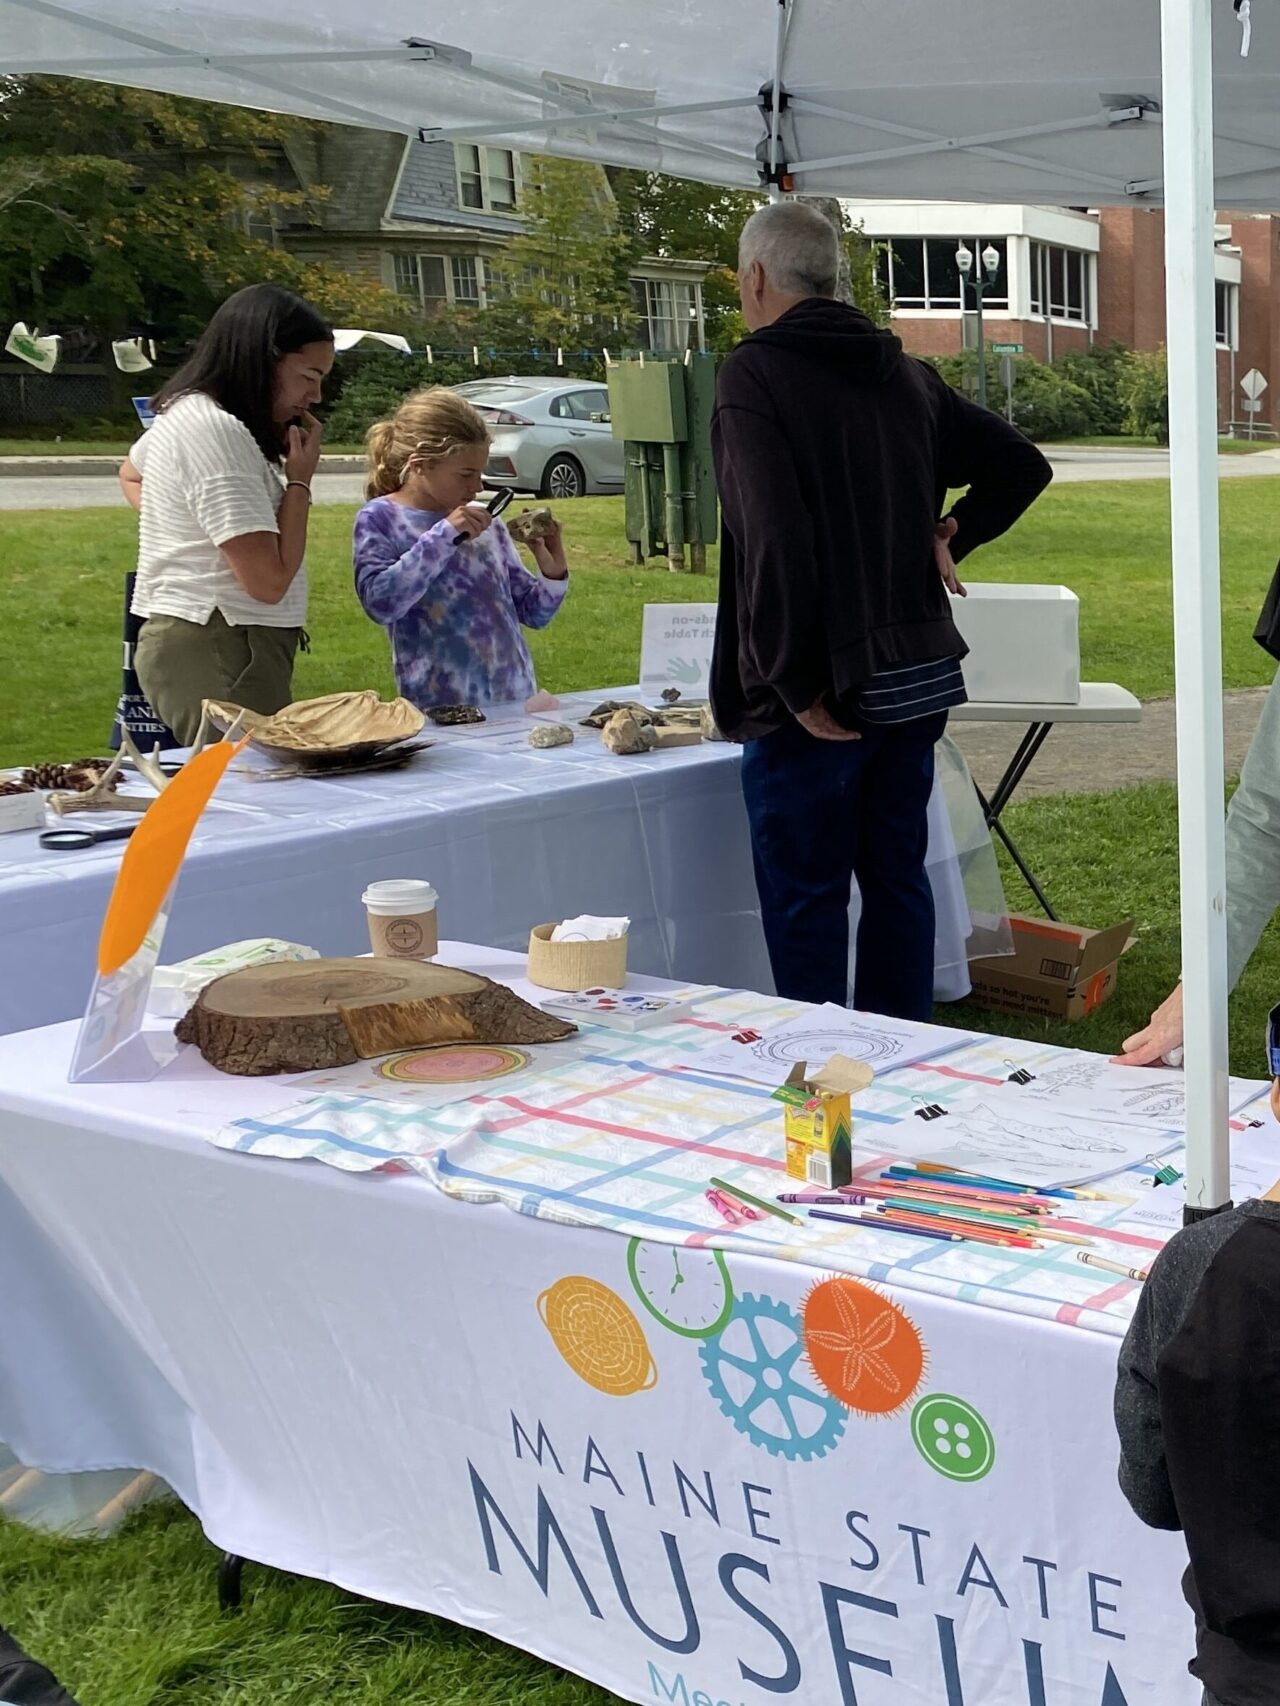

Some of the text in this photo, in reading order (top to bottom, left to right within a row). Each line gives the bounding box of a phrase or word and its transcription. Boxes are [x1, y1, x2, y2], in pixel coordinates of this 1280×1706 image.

[466, 1456, 1130, 1706] MUSEU
[509, 1408, 1127, 1641] MAINE STATE
